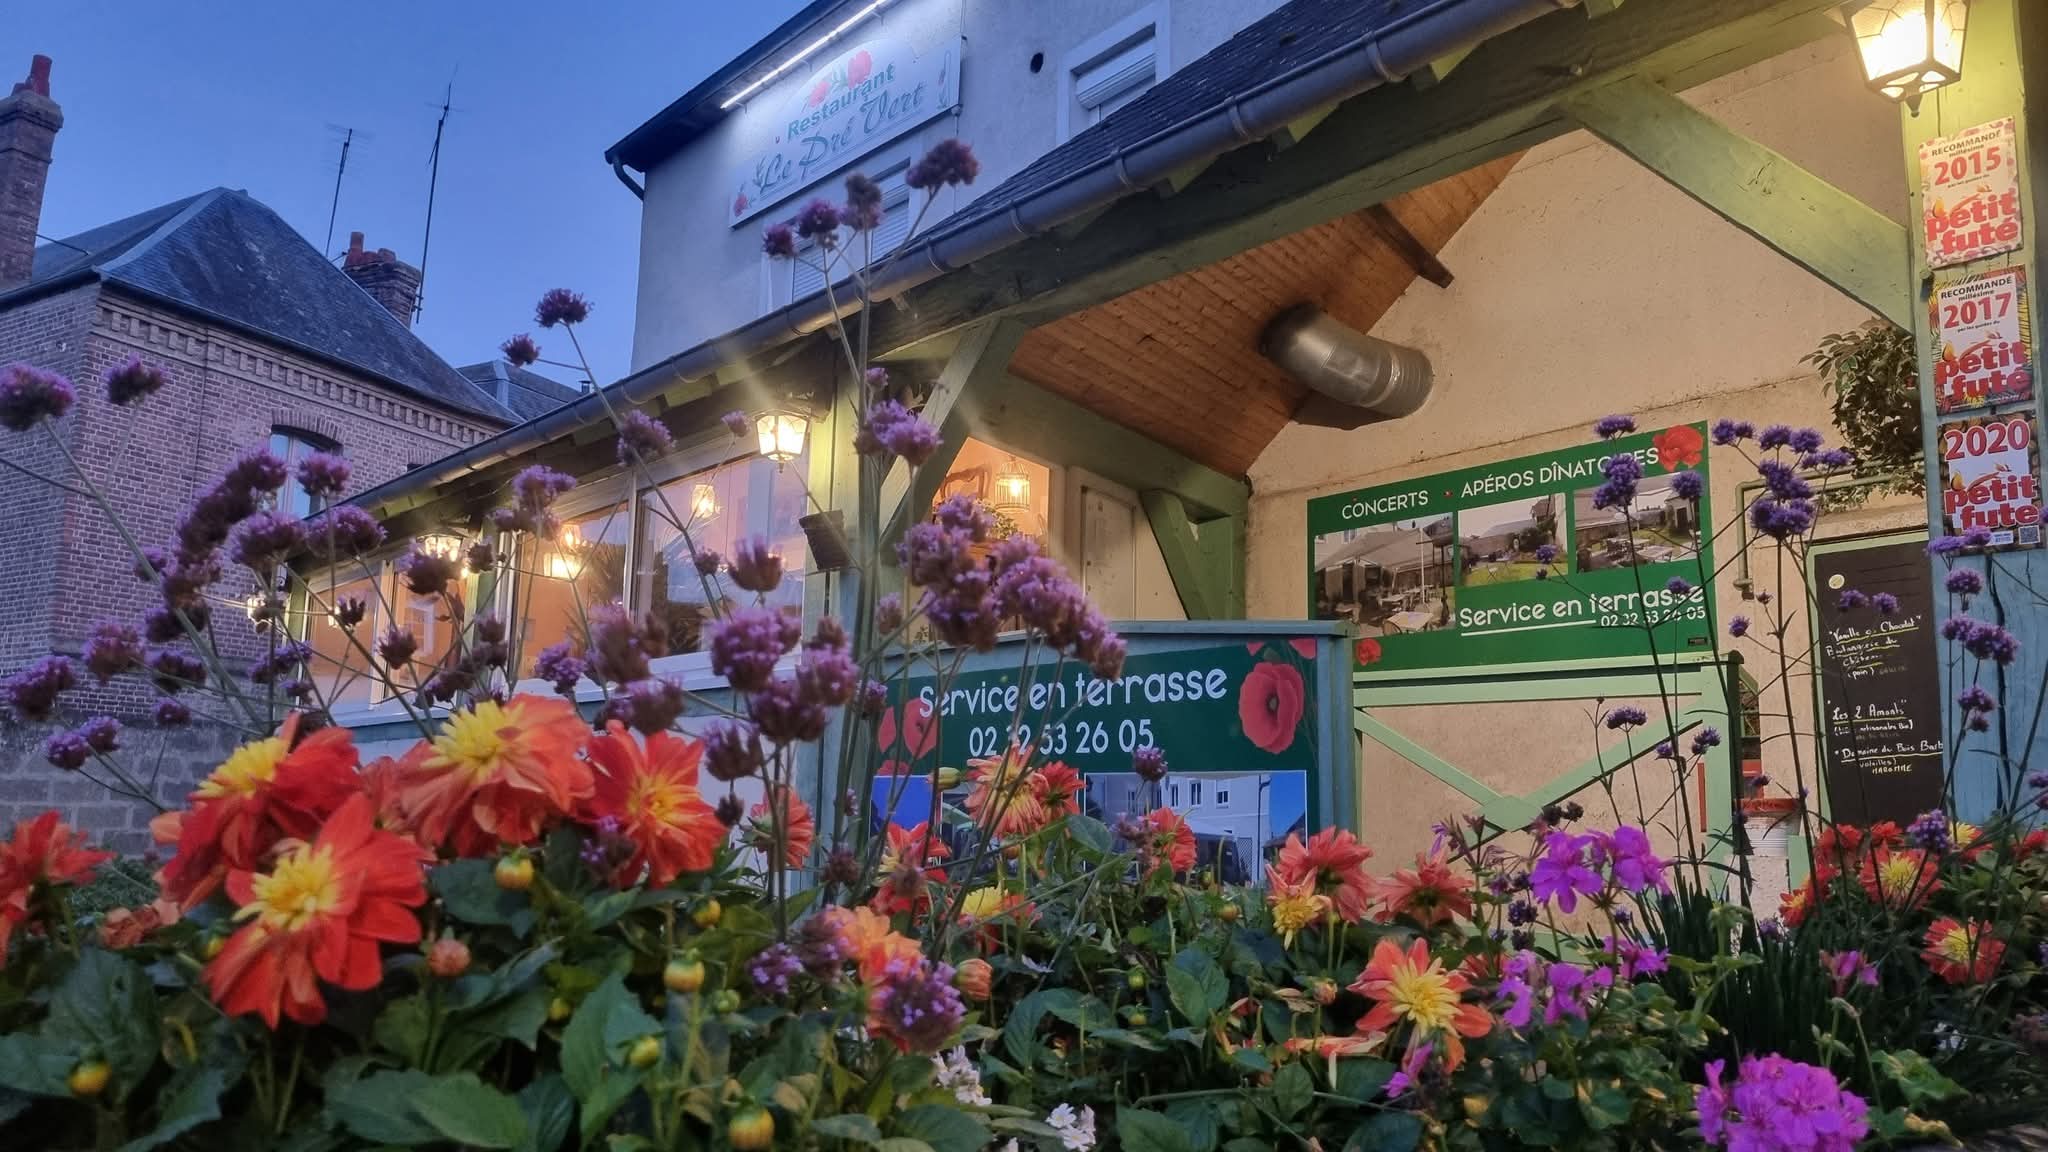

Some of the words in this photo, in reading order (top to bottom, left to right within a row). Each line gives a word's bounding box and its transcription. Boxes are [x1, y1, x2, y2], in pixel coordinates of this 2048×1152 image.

[787, 63, 895, 142] Restaurant
[760, 153, 792, 193] Le
[798, 116, 854, 182] Pré
[860, 81, 925, 135] Vert
[1934, 146, 2002, 186] 2015
[1927, 187, 2017, 242] petit
[1941, 216, 2018, 255] futé
[1941, 276, 2013, 299] RECOMMANDÉ
[1943, 292, 2012, 329] 2017
[1936, 341, 2027, 386] petit
[1952, 366, 2031, 400] futé
[1944, 419, 2030, 461] 2020
[1342, 490, 1429, 520] CONCERTS
[1460, 470, 1534, 498] APÉROS
[1540, 447, 1659, 484] DÎNATOES
[1944, 474, 2037, 514] petit
[1460, 602, 1546, 628] Service
[1553, 595, 1582, 617] en
[1601, 615, 1618, 627] 02
[1686, 605, 1706, 619] 05
[919, 680, 1019, 718] Service
[1028, 681, 1066, 711] en
[1076, 668, 1228, 707] terrasse
[1854, 705, 1863, 719] 2
[969, 726, 998, 757] 02
[1006, 723, 1032, 755] 2
[1075, 721, 1109, 754] 26
[1119, 719, 1154, 753] 05
